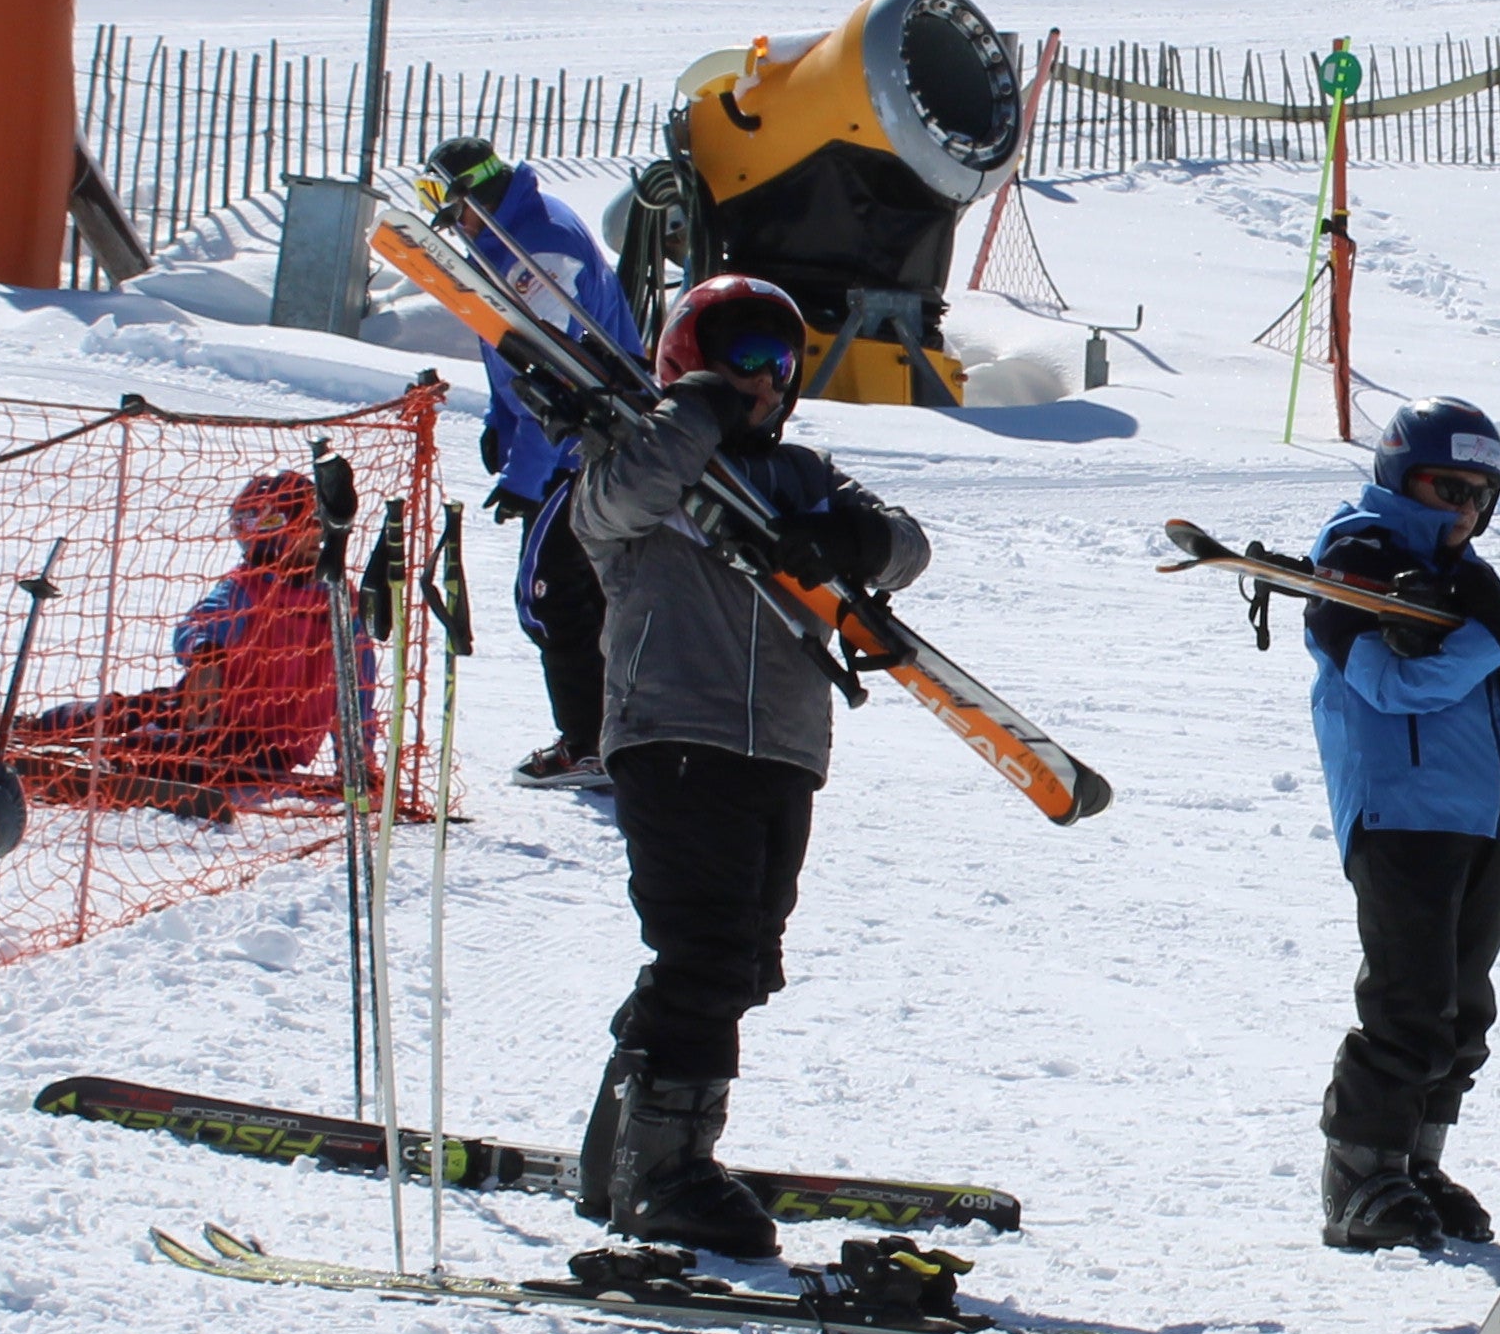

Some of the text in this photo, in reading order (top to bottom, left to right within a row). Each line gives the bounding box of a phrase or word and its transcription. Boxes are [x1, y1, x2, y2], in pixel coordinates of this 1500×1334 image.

[906, 679, 1032, 789] HEAD
[97, 1107, 324, 1160] FISCHER
[959, 1192, 998, 1212] 160
